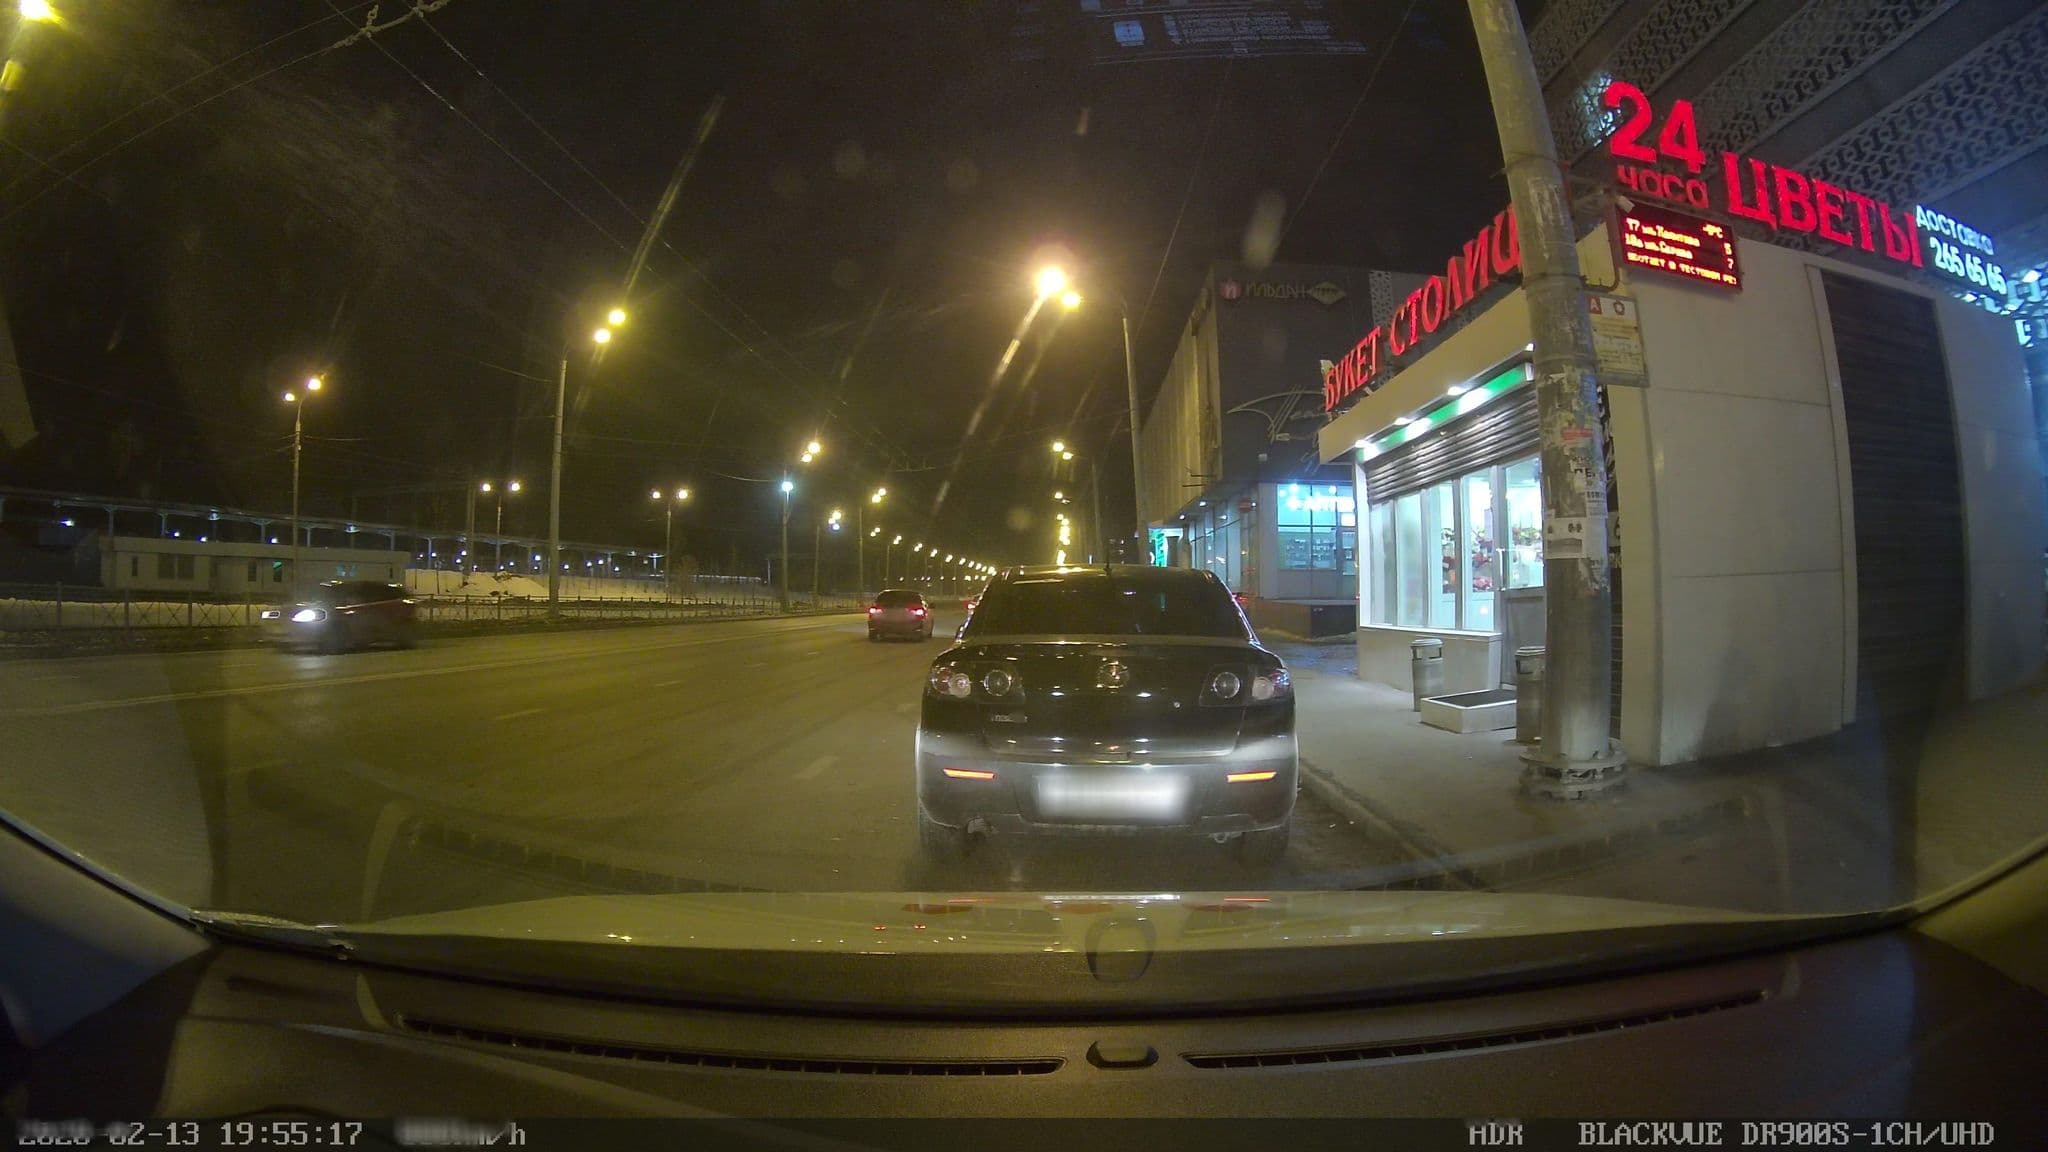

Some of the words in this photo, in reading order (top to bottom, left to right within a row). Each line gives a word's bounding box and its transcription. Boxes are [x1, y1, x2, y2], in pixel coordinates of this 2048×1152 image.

[1604, 81, 1707, 174] 24
[1722, 151, 1924, 268] ЦВЕТЫ
[1325, 325, 1381, 412] БУКЕТ
[1390, 202, 1522, 356] СТОЛИЦ
[1930, 236, 1965, 277] 265
[1965, 252, 1988, 286] 65
[1988, 263, 2008, 295] 65
